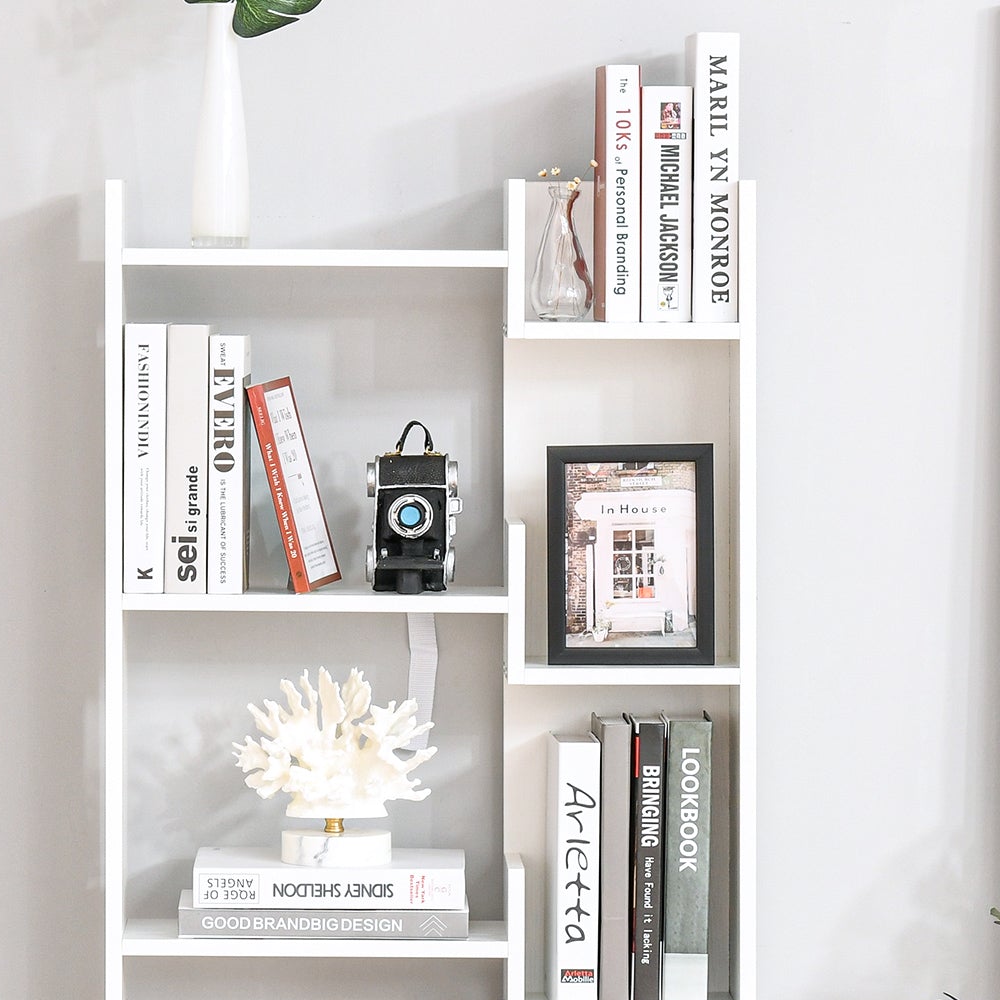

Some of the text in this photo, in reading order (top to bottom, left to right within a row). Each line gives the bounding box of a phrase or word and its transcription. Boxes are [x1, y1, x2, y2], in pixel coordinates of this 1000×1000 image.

[619, 78, 627, 94] The
[614, 156, 621, 165] of
[660, 144, 680, 210] MICHAEL
[615, 168, 628, 228] Personal
[613, 233, 628, 295] Branding
[658, 213, 680, 283] JACKSON
[710, 193, 730, 304] MONROE
[213, 368, 235, 473] EVERO
[265, 443, 273, 462] What
[271, 468, 280, 486] Wish
[276, 492, 284, 510] Knew
[172, 465, 200, 582] sei si grande
[601, 504, 667, 514] In House
[137, 567, 153, 580] K
[220, 542, 226, 551] OF
[679, 748, 700, 872] LOOKBOOK
[207, 878, 253, 888] ANGELS
[273, 883, 393, 897] SIDNEY SHELDON
[565, 782, 596, 944] Arletta
[641, 765, 660, 964] BRINGING Have Found it lacking
[202, 917, 250, 930] GOOD
[342, 918, 403, 931] DESIGN
[203, 890, 219, 900] OF
